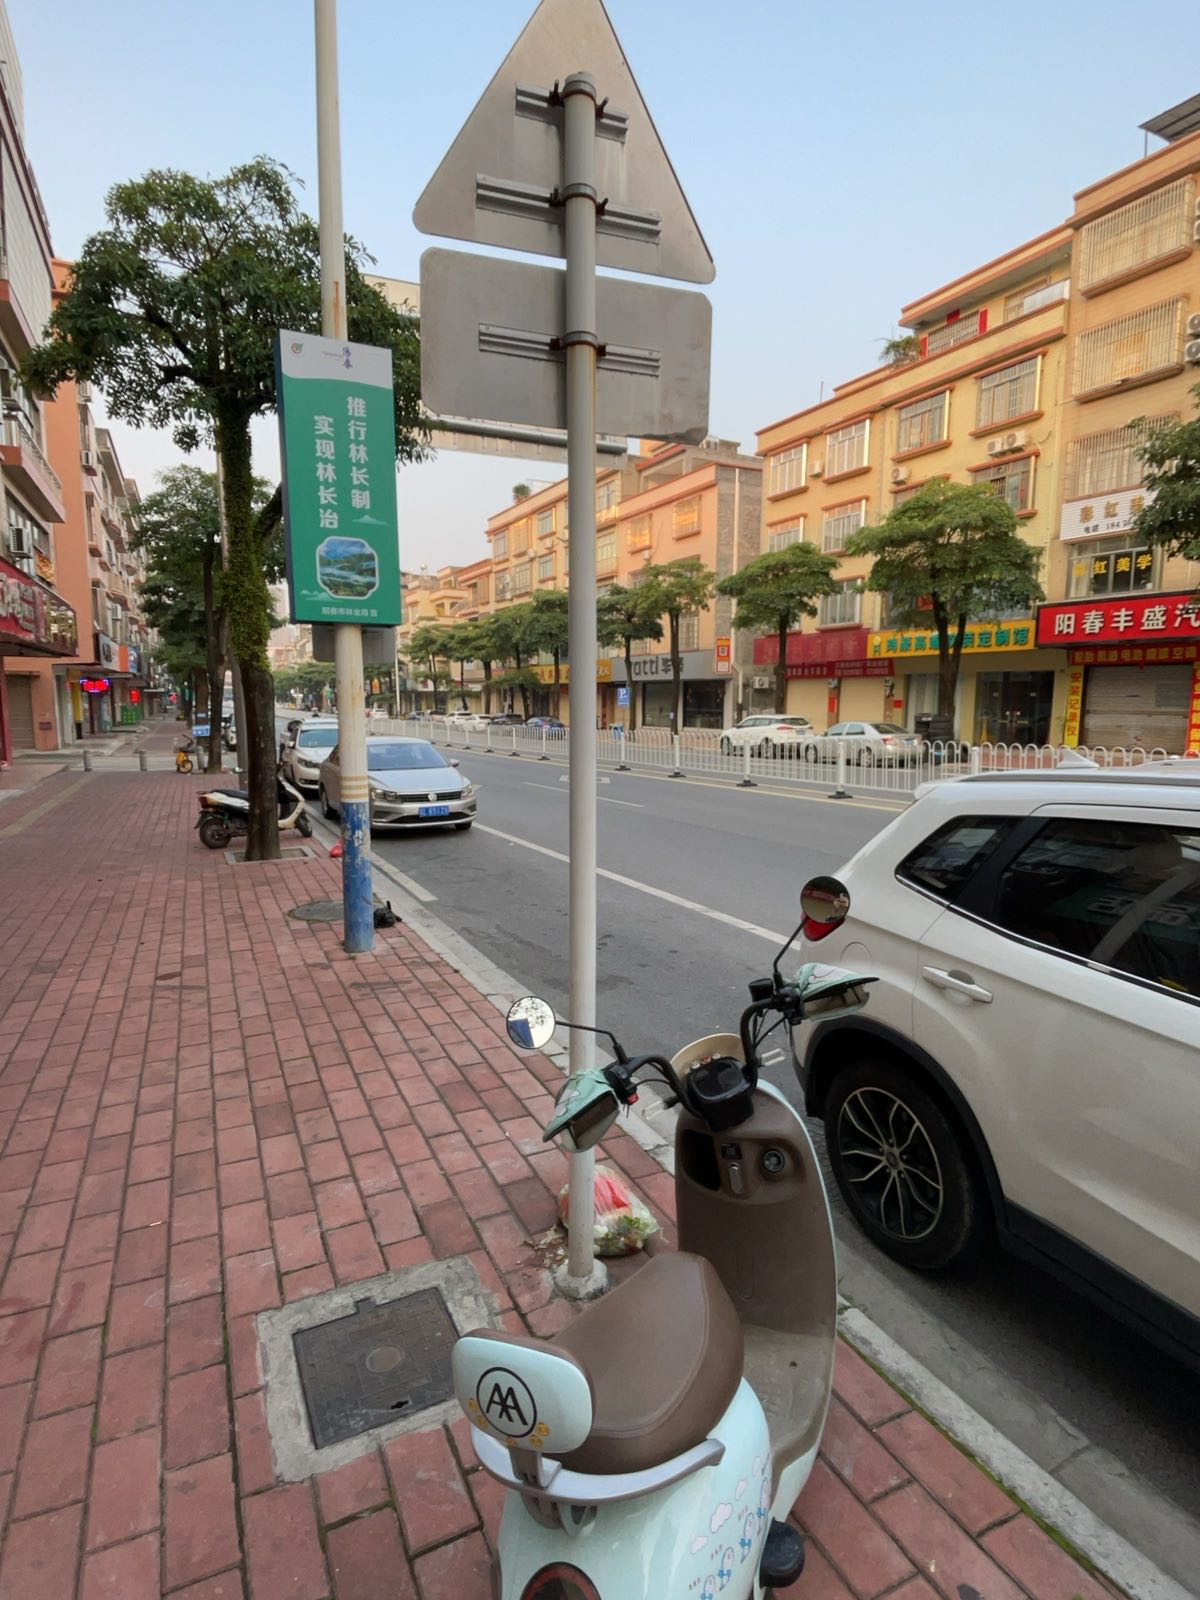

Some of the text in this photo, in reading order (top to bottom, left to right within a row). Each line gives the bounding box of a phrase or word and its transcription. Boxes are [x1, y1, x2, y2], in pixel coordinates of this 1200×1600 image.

[313, 415, 339, 529] 实现林长治
[346, 396, 371, 510] 推行林长制
[1054, 603, 1200, 635] 阳春丰盛汽
